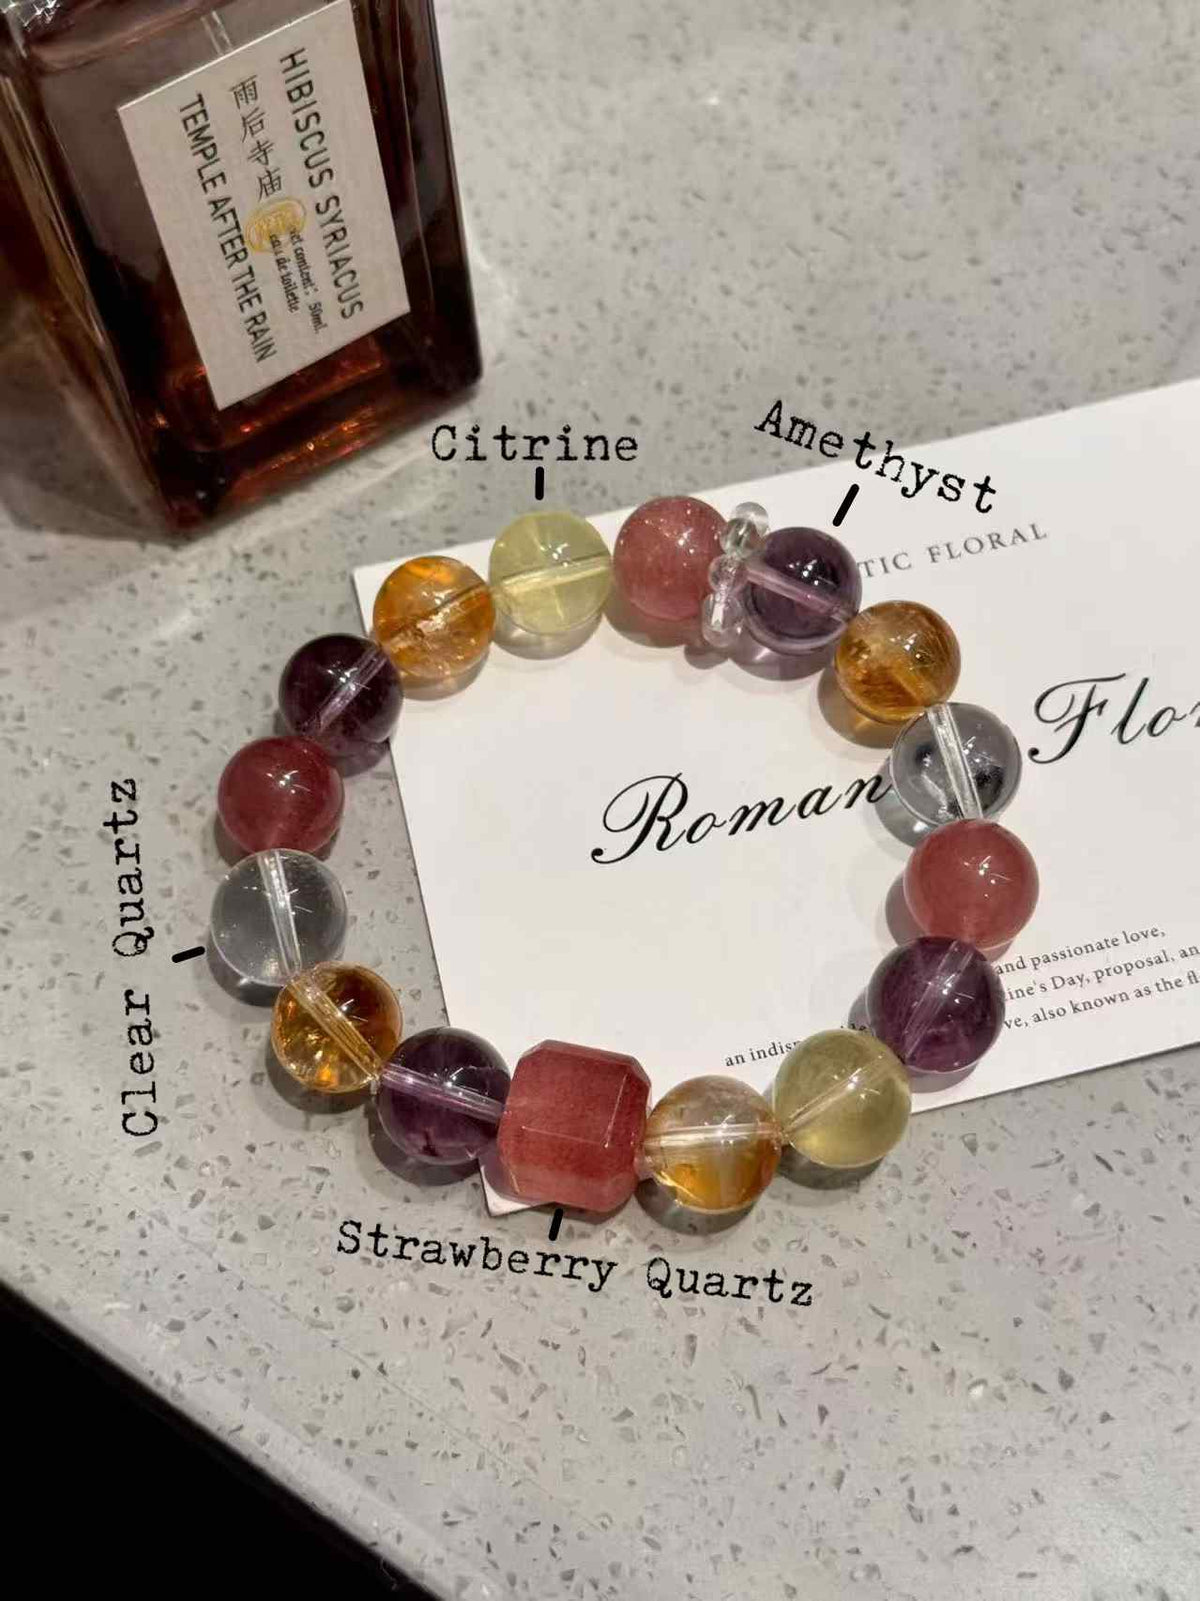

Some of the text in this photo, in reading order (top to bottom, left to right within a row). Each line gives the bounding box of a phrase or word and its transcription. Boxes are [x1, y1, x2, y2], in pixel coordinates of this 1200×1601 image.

[279, 48, 364, 320] HIBISCUS SYRIACUS
[179, 92, 277, 363] TEMPLE AFTER THE RAIN
[275, 257, 291, 271] de
[280, 271, 300, 313] toilette
[927, 523, 1048, 564] FLORAL
[995, 926, 1166, 975] and passionate love,
[724, 1053, 746, 1067] an
[1004, 979, 1048, 1001] ine's
[1051, 971, 1091, 991] Day,
[1093, 949, 1175, 983] proposal,
[1032, 1007, 1067, 1024] also
[1070, 989, 1129, 1015] known
[1134, 985, 1152, 998] as
[1156, 977, 1184, 993] the
